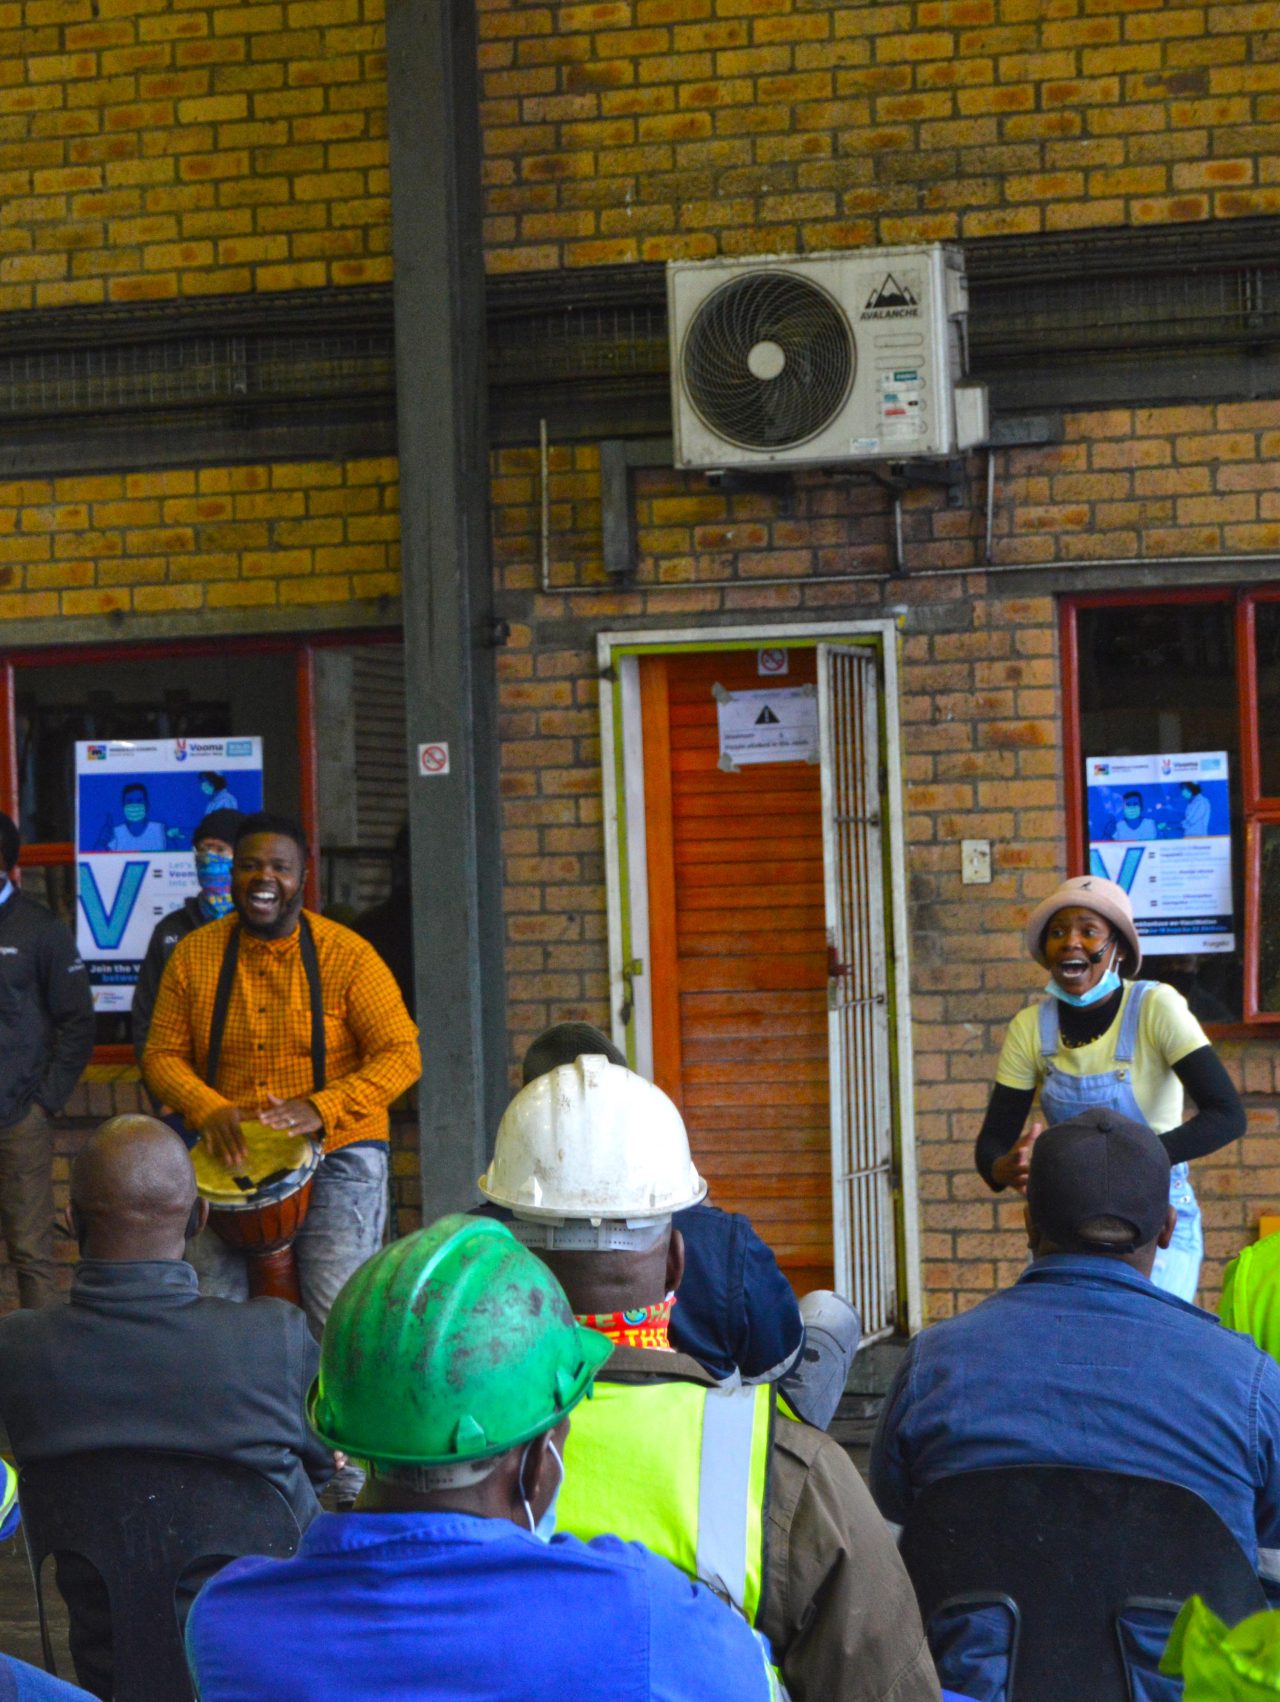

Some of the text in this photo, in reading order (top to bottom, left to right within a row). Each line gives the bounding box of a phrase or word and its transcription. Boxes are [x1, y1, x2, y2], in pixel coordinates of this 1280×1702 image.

[860, 308, 919, 321] AVALANCHE
[190, 743, 224, 752] Vooma
[169, 870, 197, 878] Voom
[79, 861, 150, 950] V
